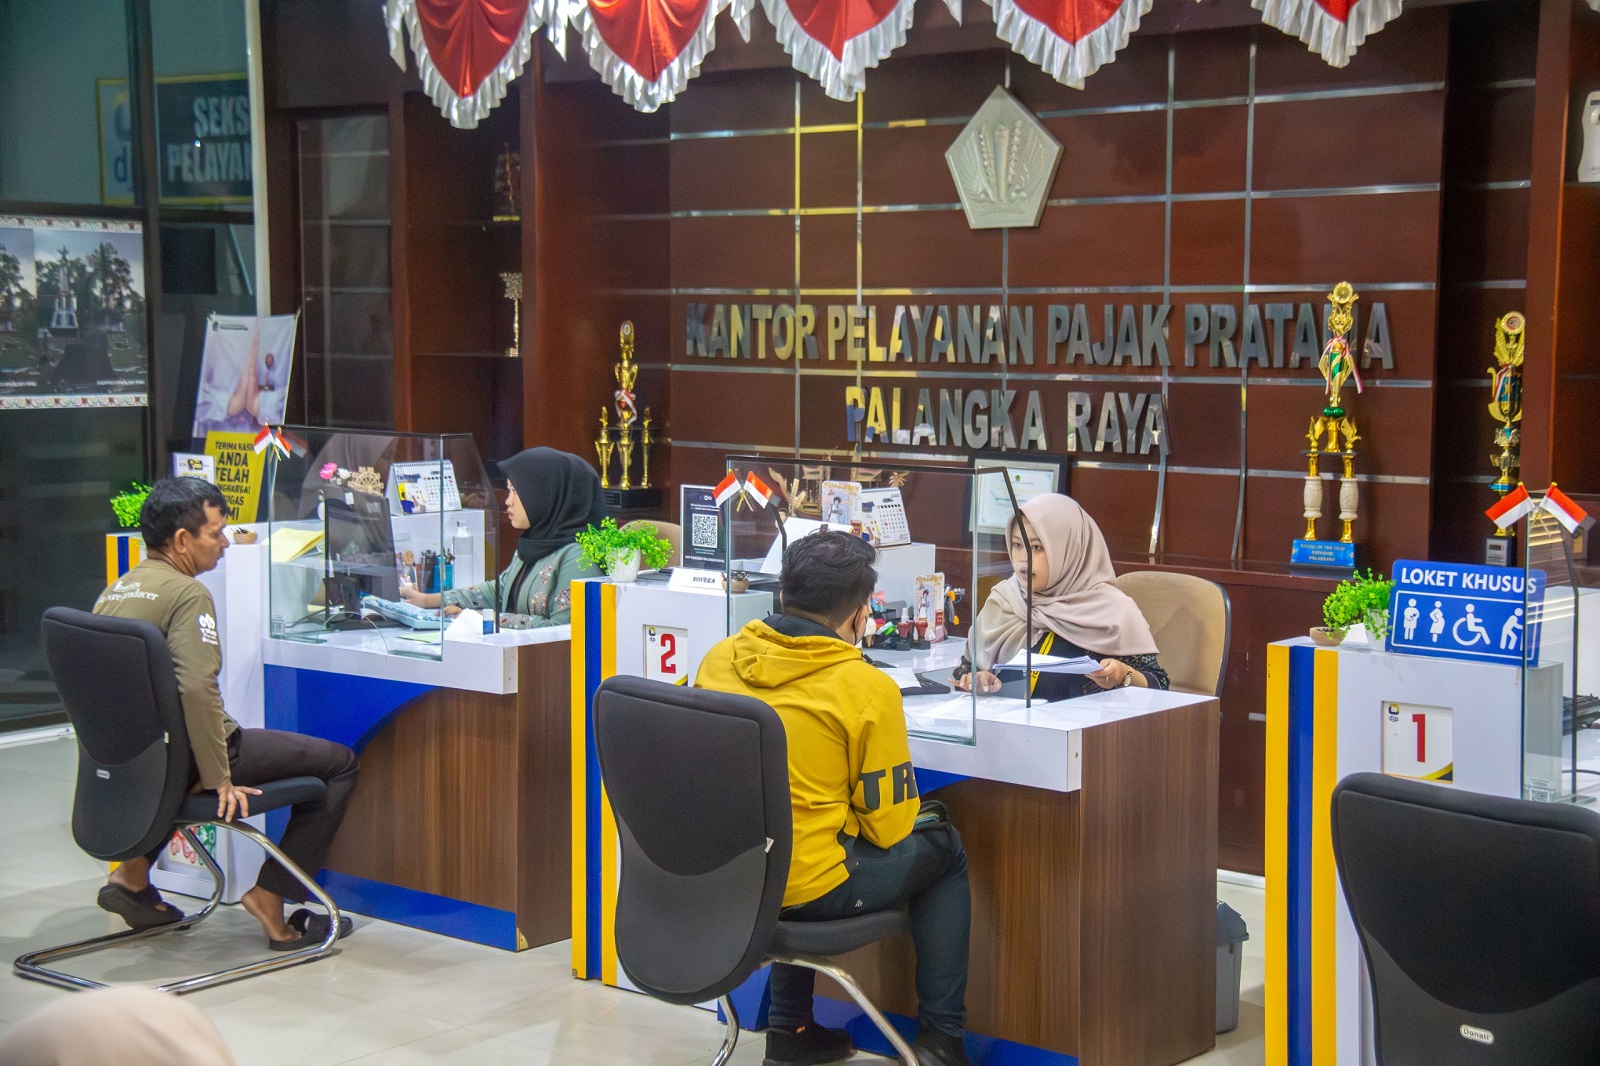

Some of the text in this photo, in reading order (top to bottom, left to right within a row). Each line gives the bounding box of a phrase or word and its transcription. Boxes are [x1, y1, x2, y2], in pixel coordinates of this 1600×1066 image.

[686, 303, 1394, 370] KANTOR PELAYANAN PAJAK PRATAA
[846, 386, 1168, 455] PALANGKA RAYA
[215, 441, 237, 450] TERIMA
[218, 452, 248, 467] ANDA
[216, 467, 250, 483] TELAH
[1401, 567, 1537, 595] LOKET KHUSUS
[660, 633, 677, 675] 2
[1411, 713, 1426, 763] 1
